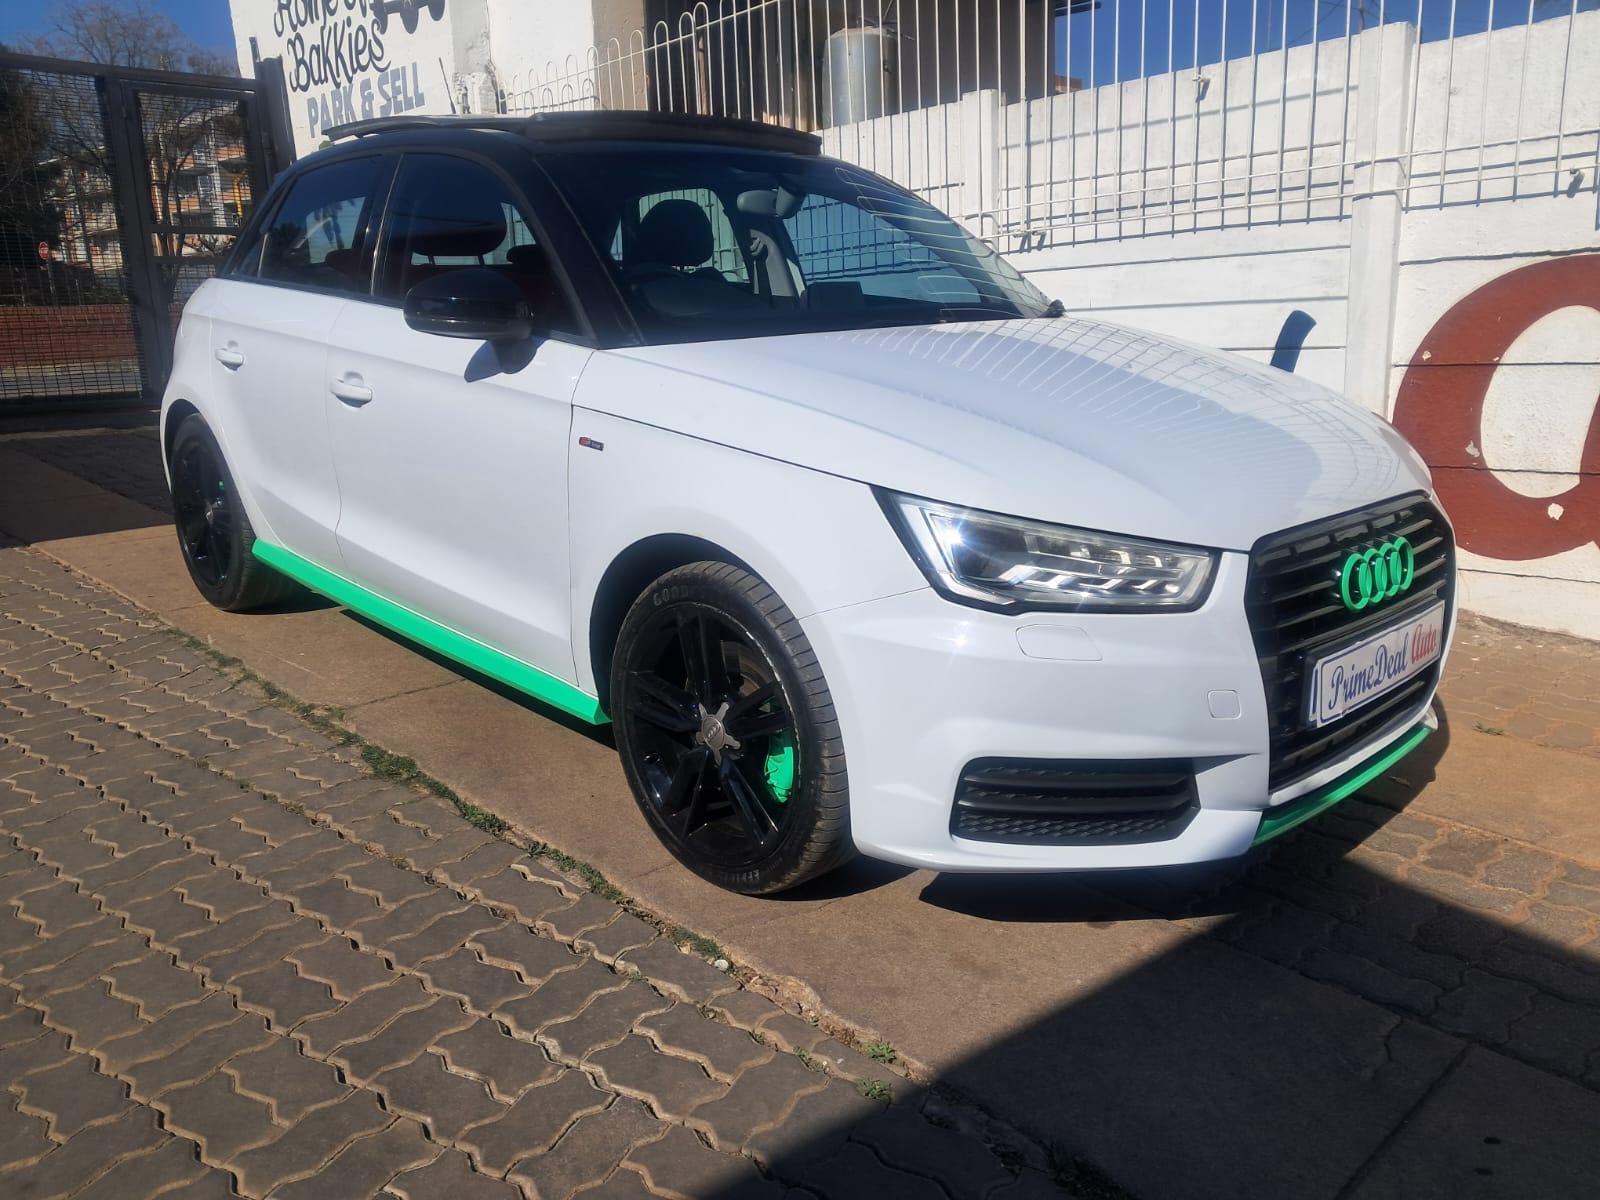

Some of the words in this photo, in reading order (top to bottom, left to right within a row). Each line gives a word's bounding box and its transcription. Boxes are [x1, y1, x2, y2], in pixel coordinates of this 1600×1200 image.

[287, 16, 391, 92] Bakkies
[306, 84, 357, 138] PARK
[360, 77, 374, 120] &
[377, 62, 425, 117] SELL
[1328, 632, 1409, 710] PrimeDeal
[1411, 624, 1437, 663] Auto
